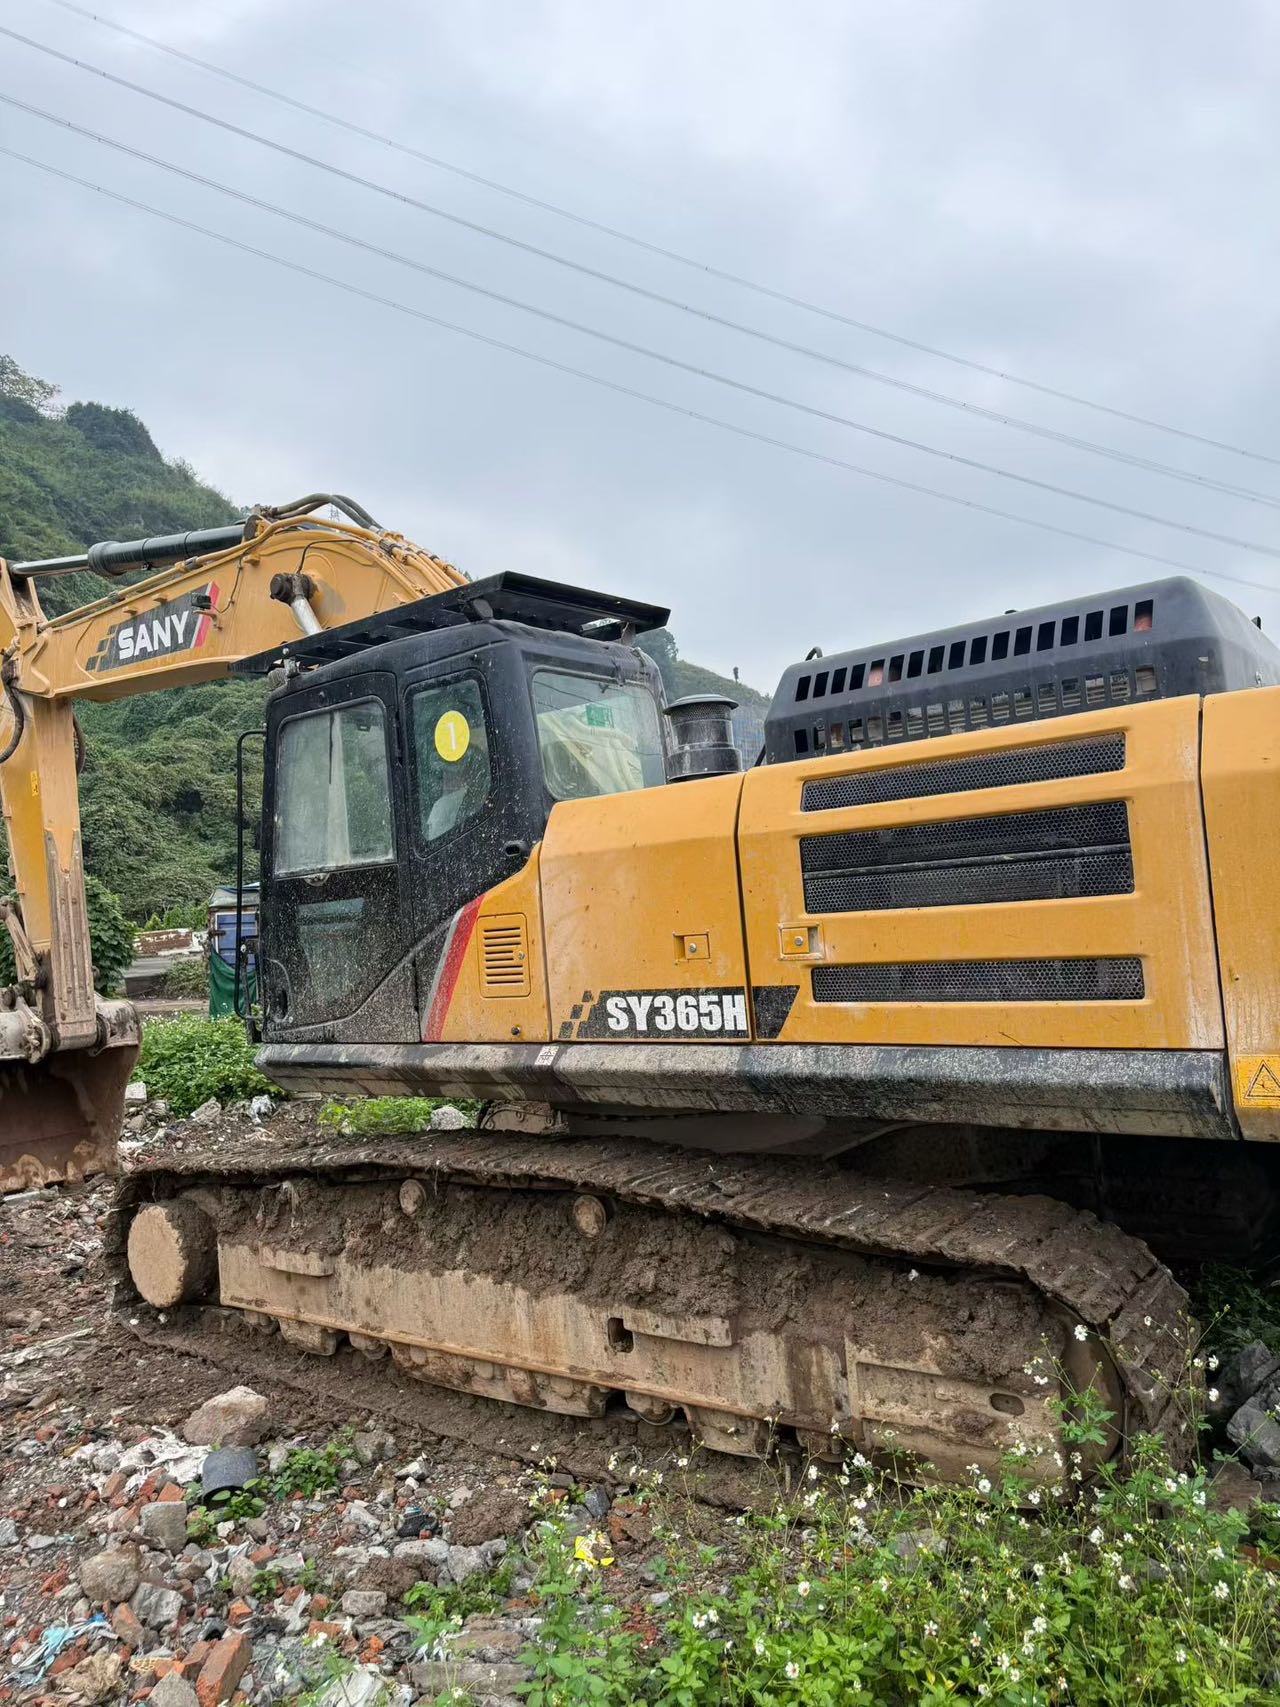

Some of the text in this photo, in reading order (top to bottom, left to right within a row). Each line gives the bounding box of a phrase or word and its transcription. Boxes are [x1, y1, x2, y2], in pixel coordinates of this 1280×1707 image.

[118, 610, 189, 660] SANY
[447, 721, 457, 753] 1
[606, 995, 747, 1031] SY365H
